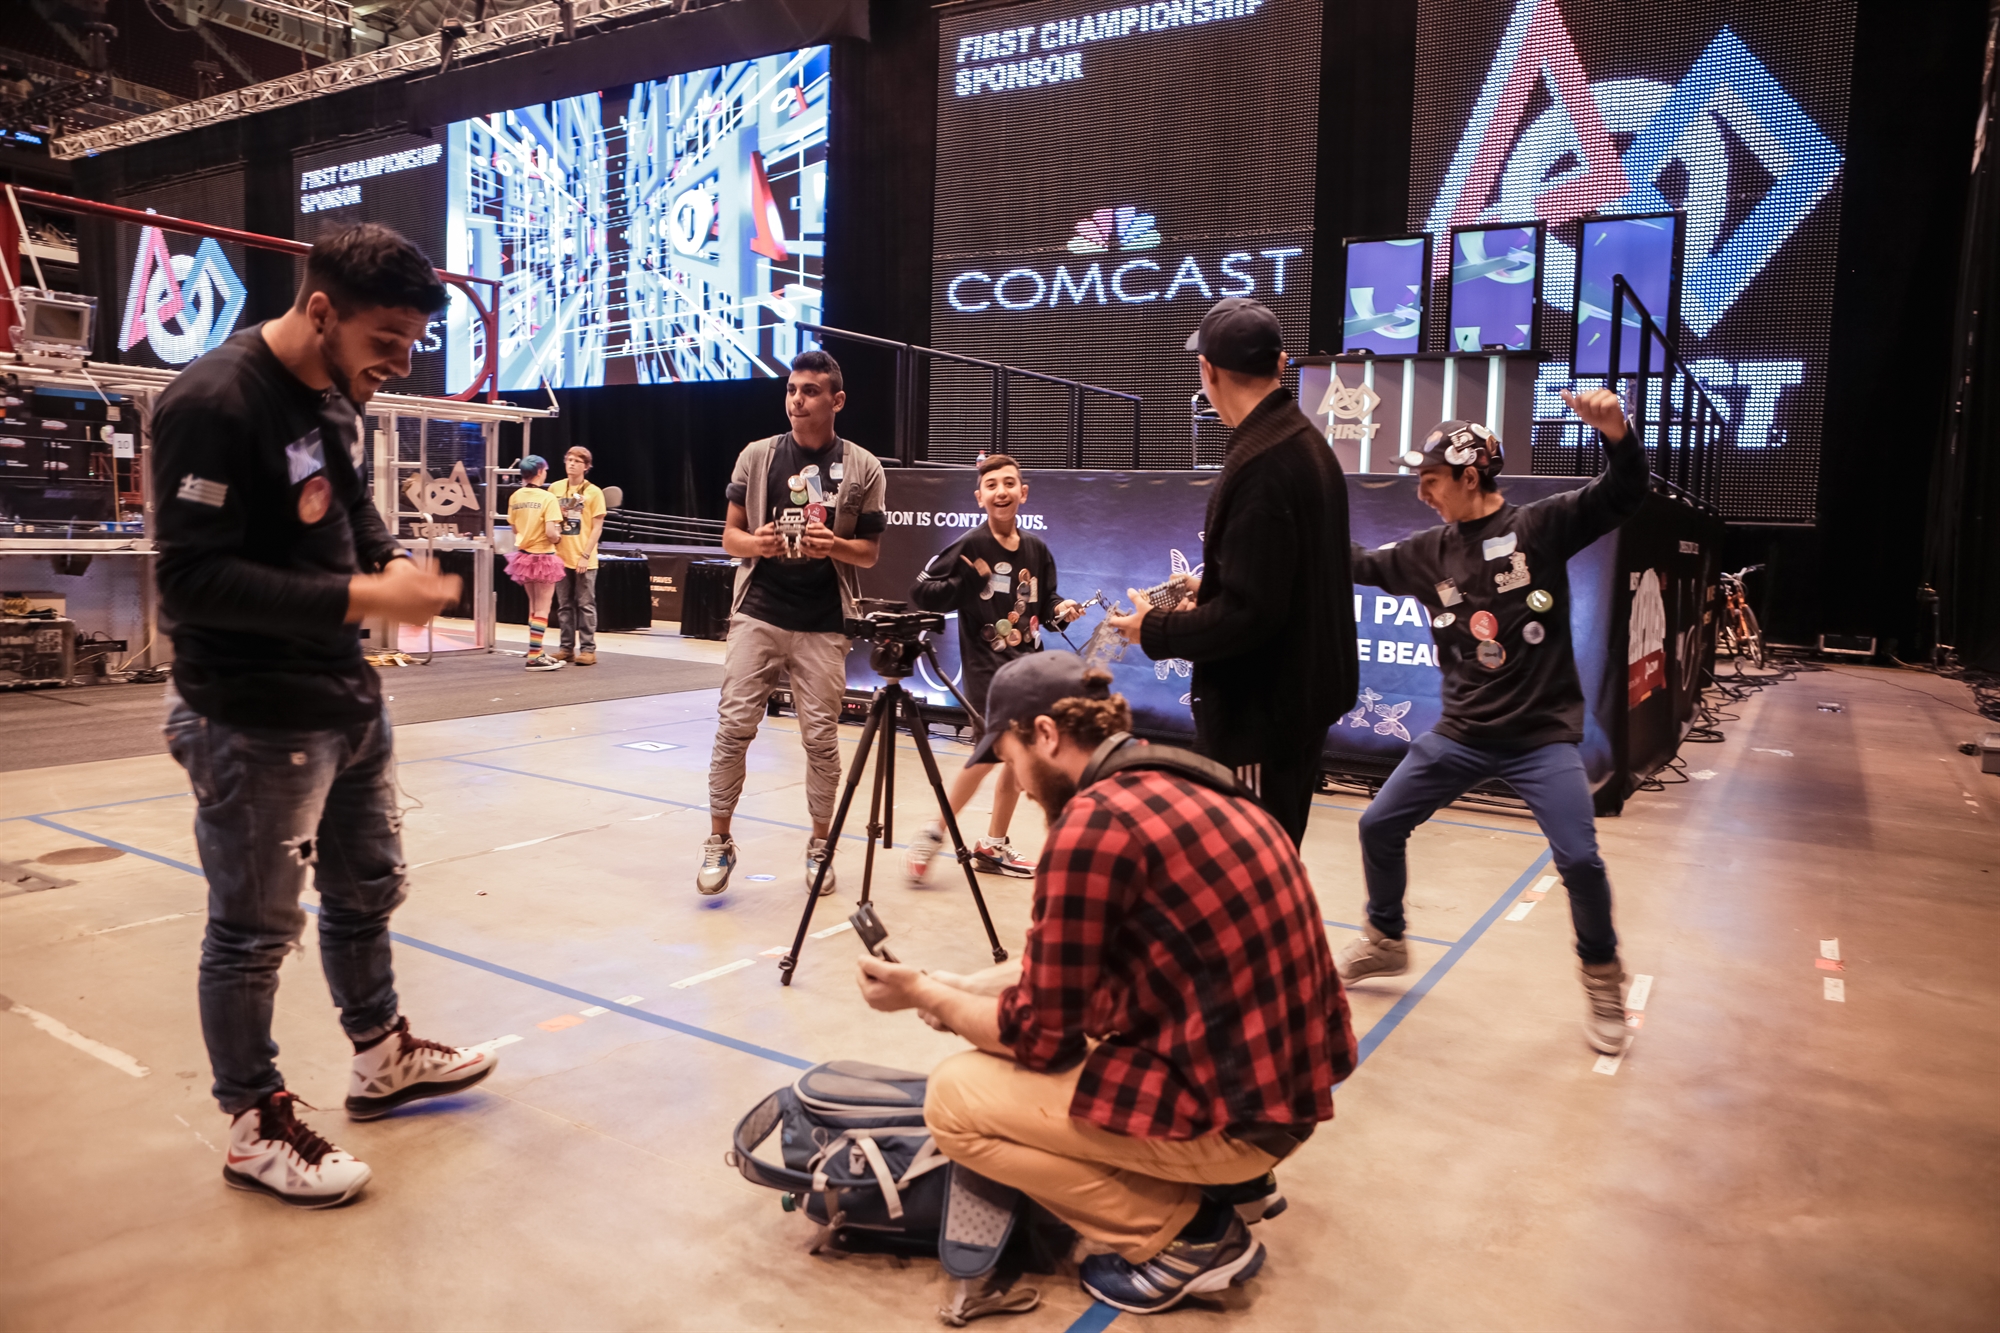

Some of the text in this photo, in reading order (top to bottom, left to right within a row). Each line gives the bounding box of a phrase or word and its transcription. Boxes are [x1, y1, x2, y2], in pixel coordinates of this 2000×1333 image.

[251, 7, 280, 29] 442
[955, 26, 1036, 63] FIRST
[955, 53, 1084, 95] SPONSOR
[301, 165, 339, 190] FIRST
[946, 248, 1302, 312] COMCAST
[1324, 423, 1381, 440] FIRST
[886, 510, 1048, 530] ION IS CONTUS.
